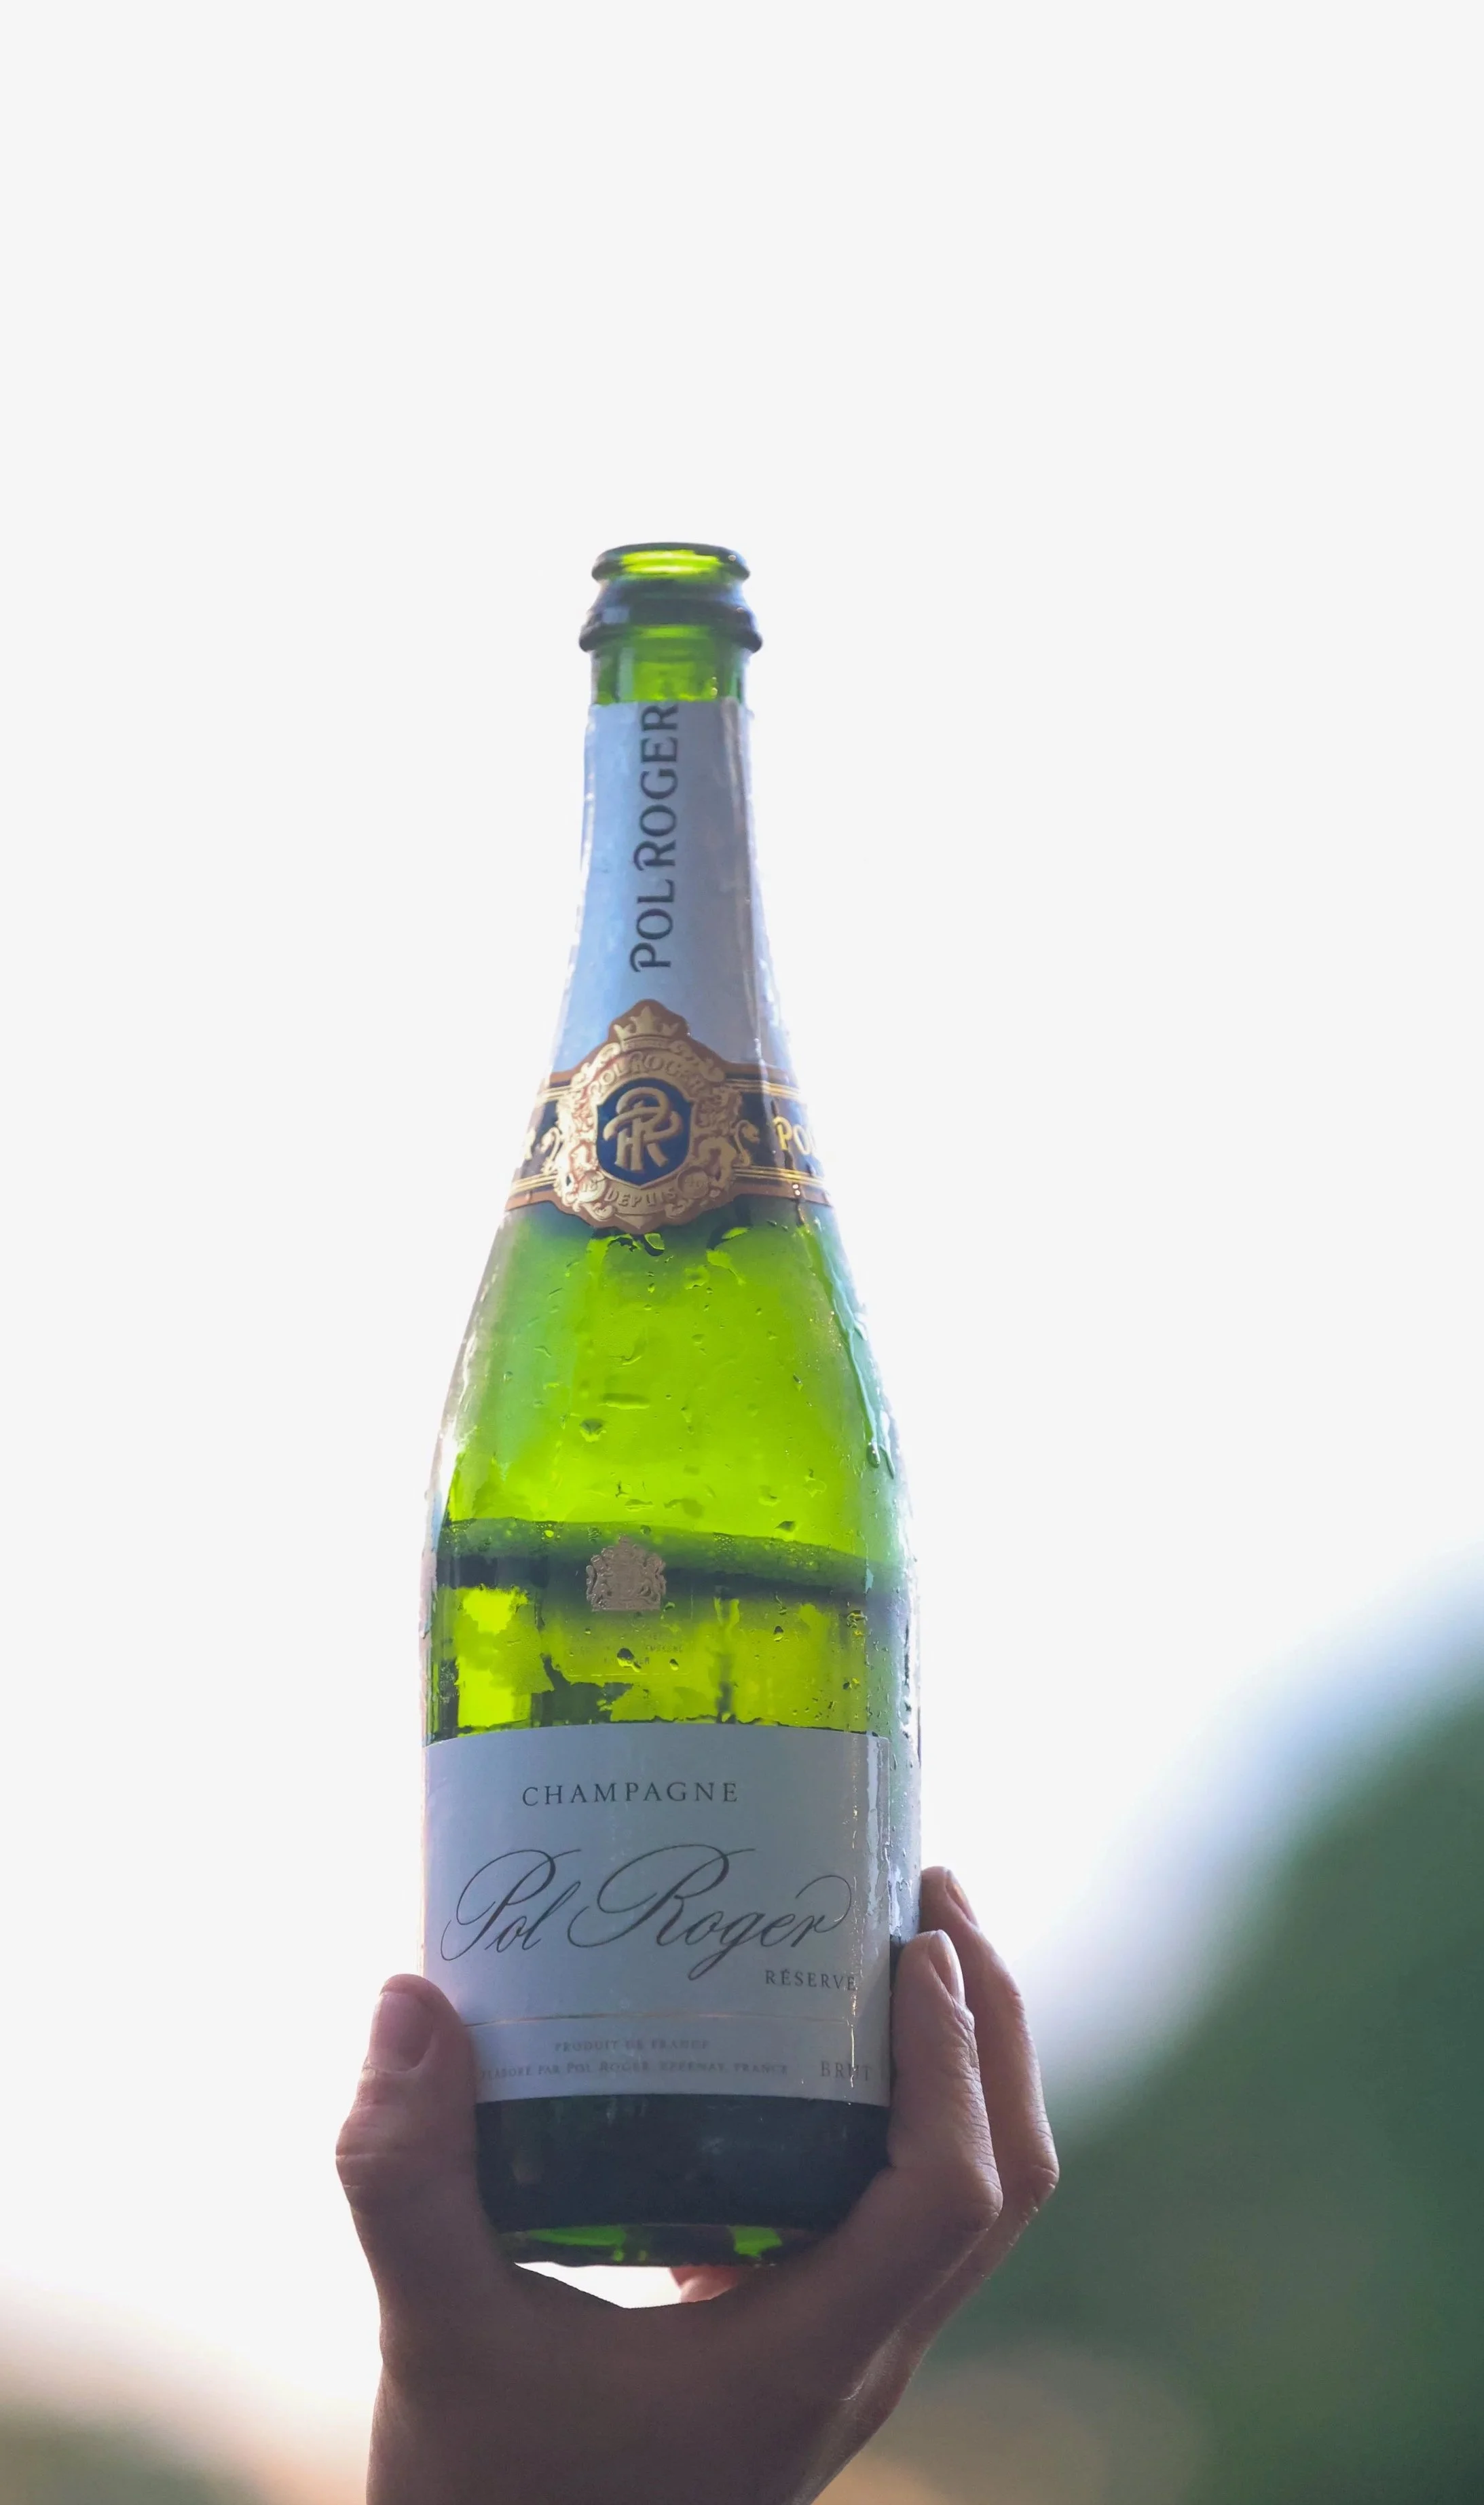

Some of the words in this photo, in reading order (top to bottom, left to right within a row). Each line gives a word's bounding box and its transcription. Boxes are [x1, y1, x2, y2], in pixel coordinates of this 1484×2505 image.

[634, 703, 680, 871] ROGER
[630, 878, 675, 972] POL
[521, 1781, 739, 1807] CHAMPAGNE
[441, 1849, 582, 1961] Pol
[567, 1844, 852, 1981] Roger
[765, 1969, 857, 1991] RÉSERVE
[553, 2039, 619, 2052] PRODUIT
[819, 2060, 872, 2082] BRUT
